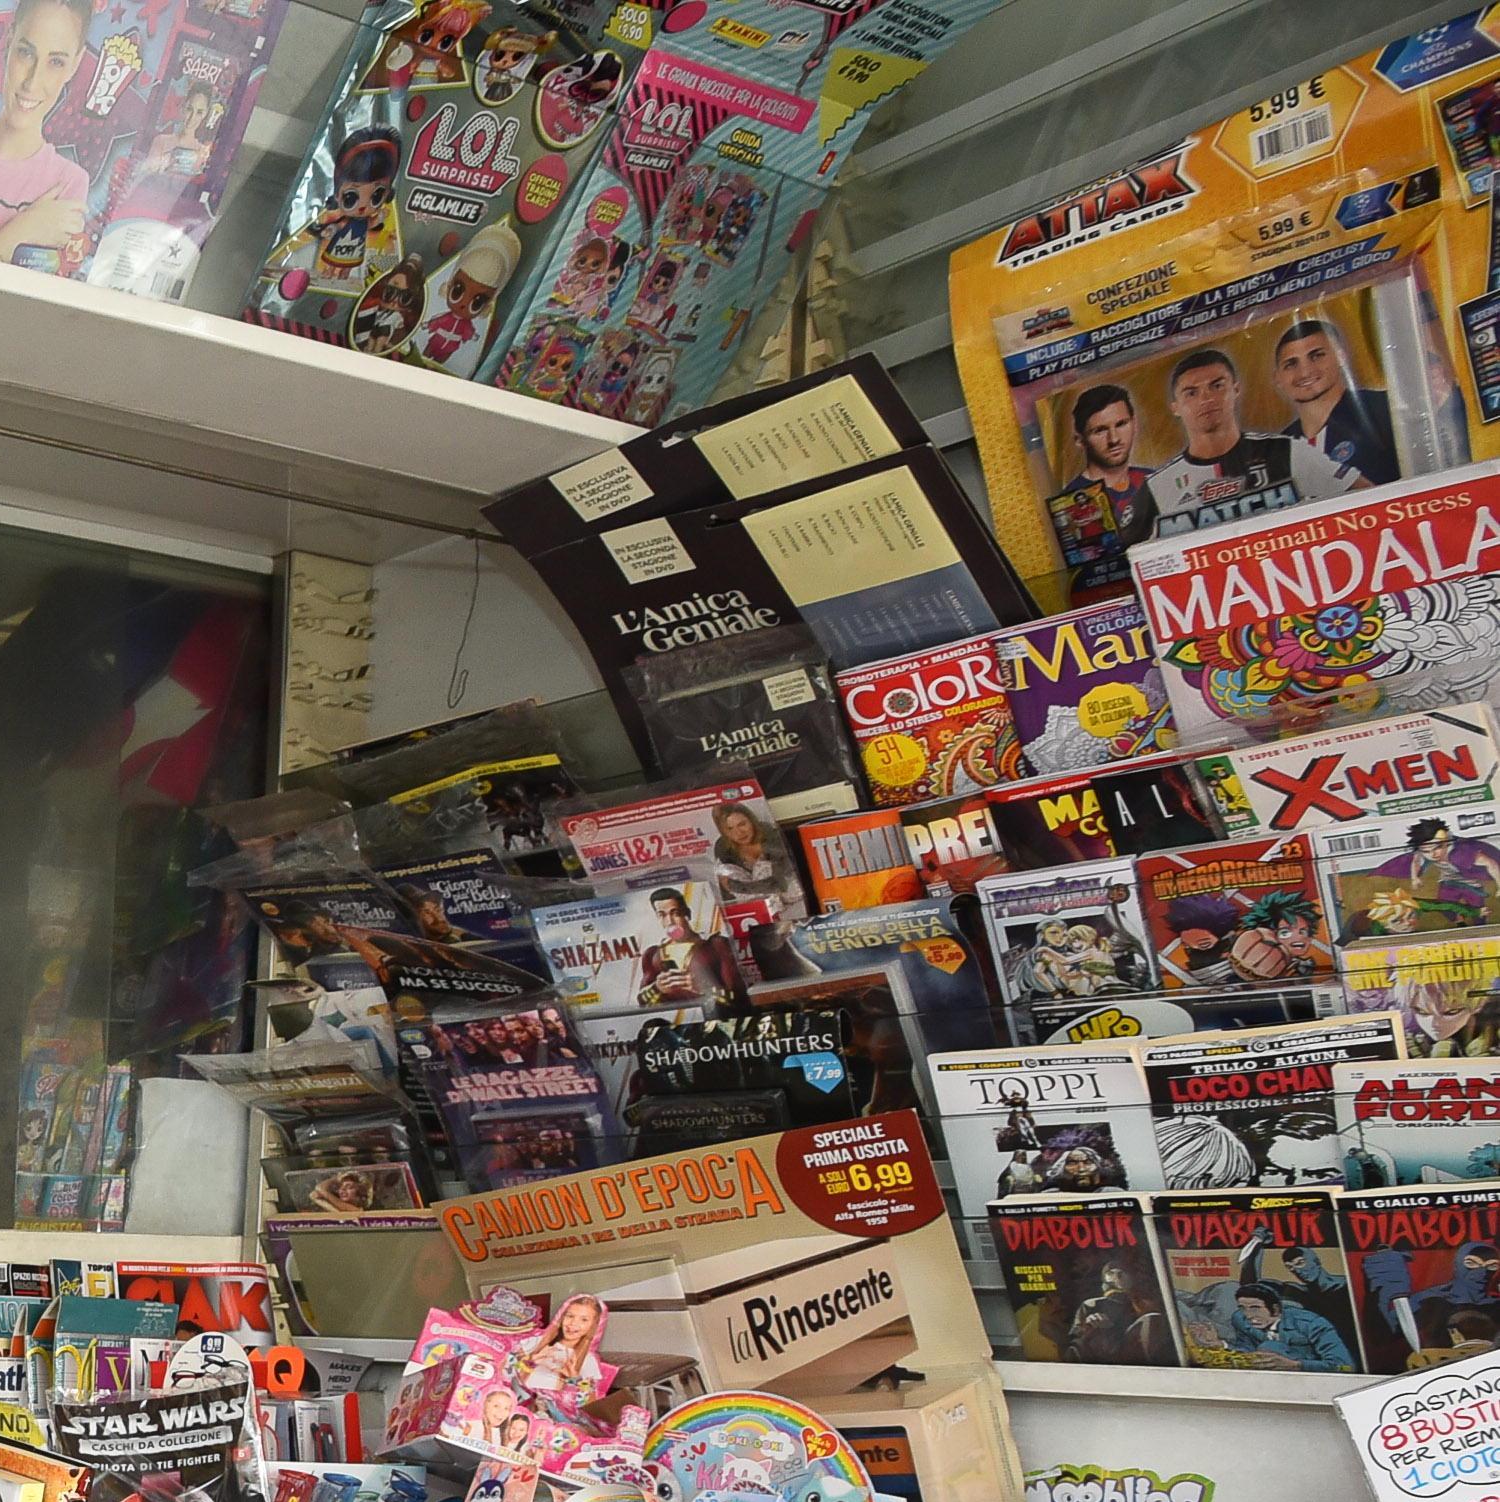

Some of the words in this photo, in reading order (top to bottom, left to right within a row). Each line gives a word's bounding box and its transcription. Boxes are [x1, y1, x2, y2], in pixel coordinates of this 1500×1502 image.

[1250, 87, 1301, 122] 5.99
[1307, 75, 1326, 98] €
[432, 112, 520, 172] LOL
[420, 162, 494, 193] SURPRISE!
[408, 191, 485, 222] #GLAMLIFE
[1013, 157, 1184, 258] ATTAX
[1010, 230, 1102, 267] TRADING
[1110, 201, 1185, 233] CARDS
[1087, 263, 1178, 306] CONFEZIONE
[1091, 302, 1184, 342] RACCOGLITORE
[1224, 272, 1276, 299] RIVISTA
[1298, 240, 1369, 273] CHECKLIST
[1101, 281, 1172, 315] SPECIALE
[1099, 326, 1166, 360] SUPERSIZE
[1233, 270, 1322, 316] REGOLAMENTO
[626, 535, 673, 551] ESCLUSIVA
[1214, 520, 1328, 567] originali
[1335, 508, 1379, 534] No
[1385, 493, 1472, 524] Stress
[634, 544, 677, 560] SECONDA
[656, 564, 675, 574] DVD
[1150, 506, 1500, 646] MANDALA
[612, 590, 750, 635] L'Amica
[642, 606, 781, 652] Geniale
[838, 660, 920, 687] CROMOTERAPIA
[905, 712, 942, 727] STRESS
[944, 696, 1005, 719] COLORANDO
[1251, 744, 1478, 829] X-MEN
[551, 935, 642, 972] SHAZAM!
[644, 1033, 834, 1066] SHADOWHUNTERS
[1191, 1059, 1256, 1075] TRILLO
[1275, 1049, 1349, 1066] ALTUNA
[971, 1071, 1102, 1105] TOPPI
[1171, 1076, 1235, 1102] LOCO
[1354, 1100, 1497, 1123] FORD
[804, 1150, 851, 1169] PRIMA
[854, 1137, 909, 1158] USCITA
[851, 1162, 913, 1193] 6,99
[443, 1176, 585, 1262] CAMION
[591, 1148, 785, 1228] D'EPOCA
[1002, 1217, 1137, 1253] DIABOLIK
[1172, 1209, 1325, 1250] DIABOLIK
[62, 1410, 154, 1436] STAR
[159, 1397, 245, 1428] WARS
[91, 1440, 135, 1452] CASCHI
[159, 1431, 220, 1447] COLLEZIONE
[1381, 1424, 1408, 1450] 8
[156, 1458, 173, 1469] TIE
[176, 1453, 220, 1466] FIGHTER
[1390, 1446, 1435, 1468] PER
[1403, 1466, 1428, 1490] 1
